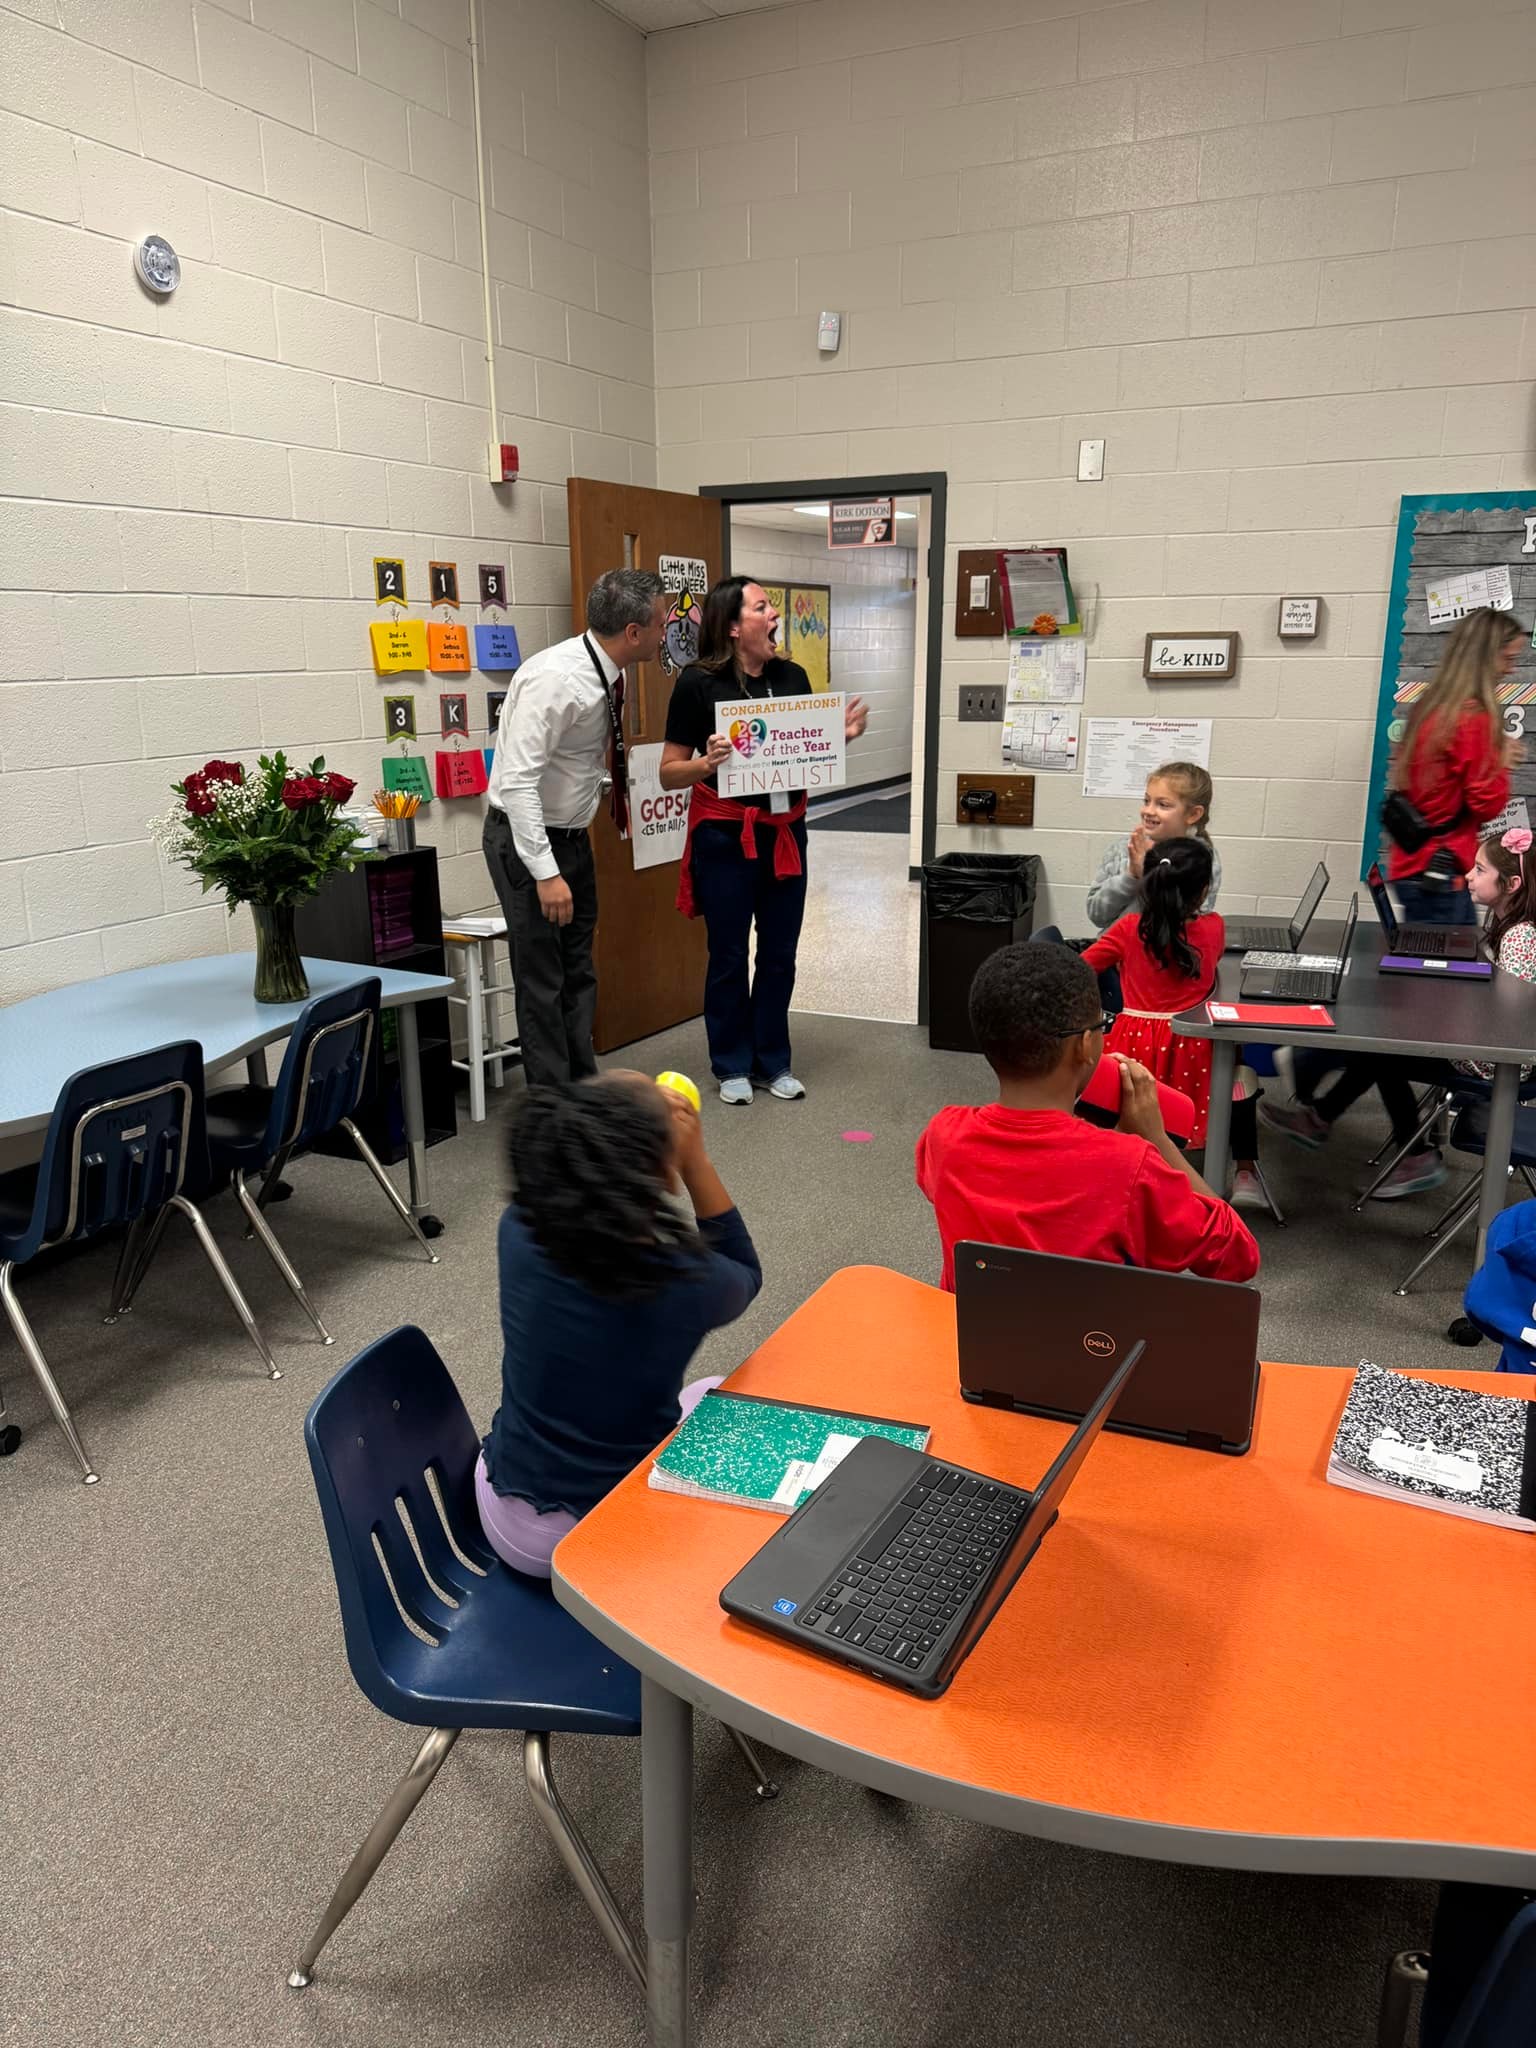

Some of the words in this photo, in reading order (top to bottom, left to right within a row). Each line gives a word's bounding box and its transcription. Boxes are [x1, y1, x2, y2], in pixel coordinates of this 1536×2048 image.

[835, 508, 854, 518] KIRK
[856, 506, 889, 517] DOTSON
[661, 559, 685, 575] Little
[688, 561, 705, 579] Miss
[385, 570, 396, 590] 2
[439, 573, 446, 592] 1
[488, 576, 497, 593] 5
[663, 576, 706, 593] ENGINEER
[1155, 647, 1182, 666] be
[1183, 653, 1225, 666] KIND
[448, 705, 460, 722] K
[721, 696, 840, 717] CONGRATULATIONS!
[395, 707, 406, 726] 3
[1503, 705, 1526, 739] 3
[738, 720, 762, 738] 20
[770, 727, 824, 742] Teacher
[738, 738, 760, 754] 25
[763, 744, 777, 757] of
[780, 743, 800, 755] the
[803, 740, 832, 752] Year
[771, 759, 789, 767] Heart
[796, 757, 808, 765] Our
[808, 754, 837, 763] Blueprint
[727, 763, 837, 794] FINALIST
[640, 790, 688, 823] GCPS
[656, 821, 667, 835] for
[1492, 820, 1507, 828] and
[1088, 1339, 1112, 1350] DELL
